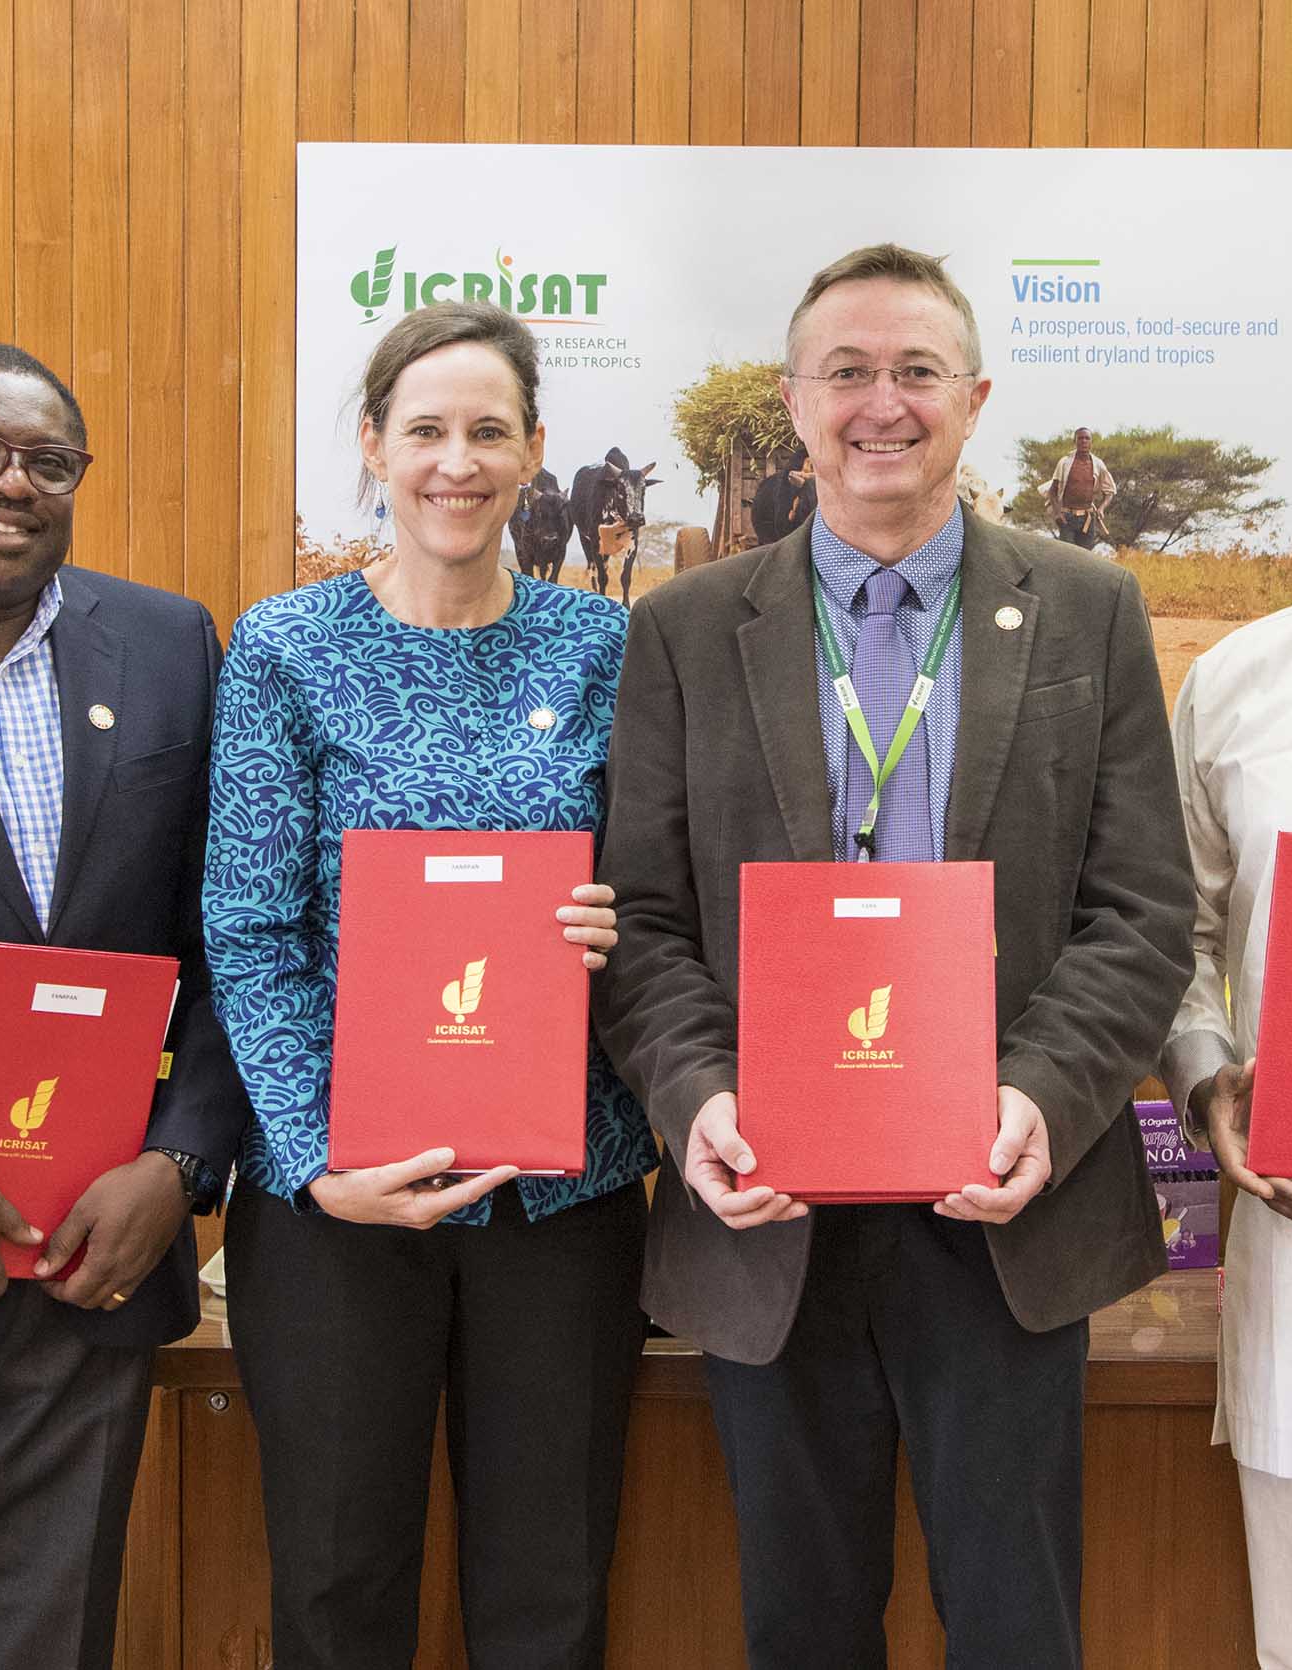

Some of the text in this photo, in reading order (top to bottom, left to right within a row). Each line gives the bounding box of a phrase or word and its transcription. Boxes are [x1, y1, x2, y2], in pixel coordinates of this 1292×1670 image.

[1012, 275, 1100, 303] Vision
[1011, 317, 1278, 338] A prosperous, food-secure and
[555, 338, 626, 350] RESEARCH
[1011, 345, 1214, 367] resilient dryland tropics
[583, 357, 641, 369] TROPICS
[435, 1025, 487, 1035] ICRISAT
[842, 1050, 895, 1060] ICRISAT
[0, 1139, 48, 1150] ICRISAT
[1141, 1129, 1178, 1148] urple
